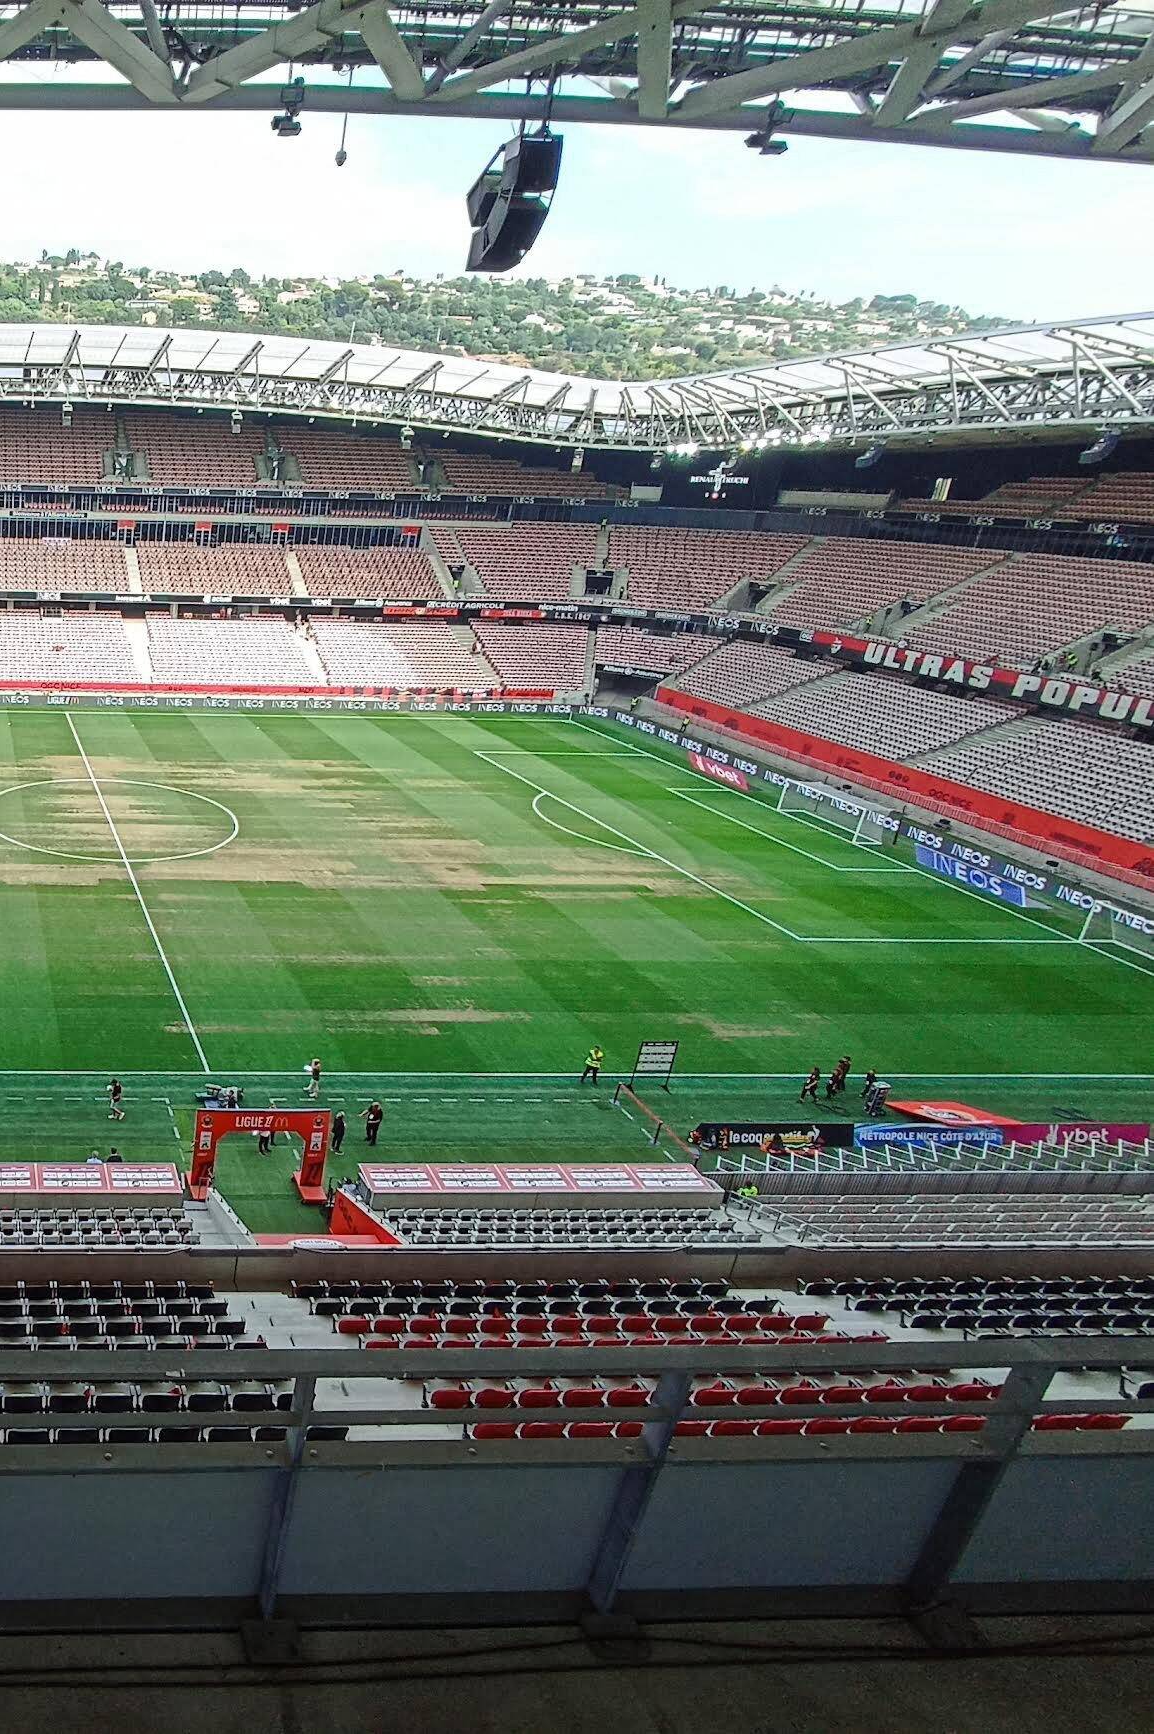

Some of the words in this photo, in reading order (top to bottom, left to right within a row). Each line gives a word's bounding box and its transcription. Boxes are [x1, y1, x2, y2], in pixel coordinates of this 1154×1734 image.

[1, 483, 22, 491] INEOS
[48, 484, 69, 492] INEOS
[95, 485, 116, 494] INEOS
[142, 486, 163, 495] INEOS
[189, 487, 210, 496] INEOS
[236, 488, 256, 496] INEOS
[282, 489, 303, 498] INEOS
[329, 490, 350, 499] INEOS
[375, 491, 395, 500] INEOS
[421, 492, 441, 502] INEOS
[466, 494, 487, 503] INEOS
[513, 495, 534, 504] INEOS
[562, 497, 585, 506] INEOS
[615, 498, 639, 508] INEOS
[802, 506, 827, 516] INEOS
[859, 508, 885, 519] INEOS
[915, 512, 940, 522] INEOS
[969, 516, 994, 526] INEOS
[1025, 519, 1052, 530] INEOS
[1088, 522, 1118, 534] INEOS
[708, 617, 741, 629] INEOS
[751, 622, 780, 636] INEOS
[863, 642, 994, 688] ULTRAS
[2, 695, 30, 704] INEOS
[47, 696, 66, 705] LIGUE
[96, 697, 124, 706] INEOS
[131, 697, 158, 706] INEOS
[166, 698, 192, 707] INEOS
[202, 698, 230, 708] INEOS
[236, 699, 264, 708] INEOS
[271, 700, 298, 708] INEOS
[305, 700, 332, 709] INEOS
[339, 701, 366, 710] INEOS
[373, 702, 400, 711] INEOS
[410, 702, 437, 711] INEOS
[444, 703, 471, 712] INEOS
[478, 703, 505, 712] INEOS
[510, 704, 538, 712] INEOS
[544, 704, 572, 713] INEOS
[578, 706, 608, 717] INEOS
[616, 712, 634, 726] INEOS
[637, 719, 655, 735] INEOS
[659, 728, 678, 744] INEOS
[681, 738, 702, 753] INEOS
[706, 748, 728, 764] INEOS
[733, 758, 758, 776] INEOS
[707, 762, 741, 785] vbet
[764, 770, 790, 788] INEOS
[830, 797, 860, 816] INEOS
[866, 810, 900, 832] INEOS
[907, 826, 943, 849] INEOS
[951, 844, 991, 867] INEOS
[933, 852, 1003, 896] INEOS
[1004, 864, 1046, 890] INEOS
[1057, 885, 1102, 913] INEOS
[236, 1116, 264, 1128] LIGUE
[730, 1130, 740, 1143] le
[741, 1133, 762, 1146] coq
[916, 1131, 938, 1141] NICE
[965, 1131, 997, 1141] D'AZUR
[1063, 1128, 1109, 1144] vbet
